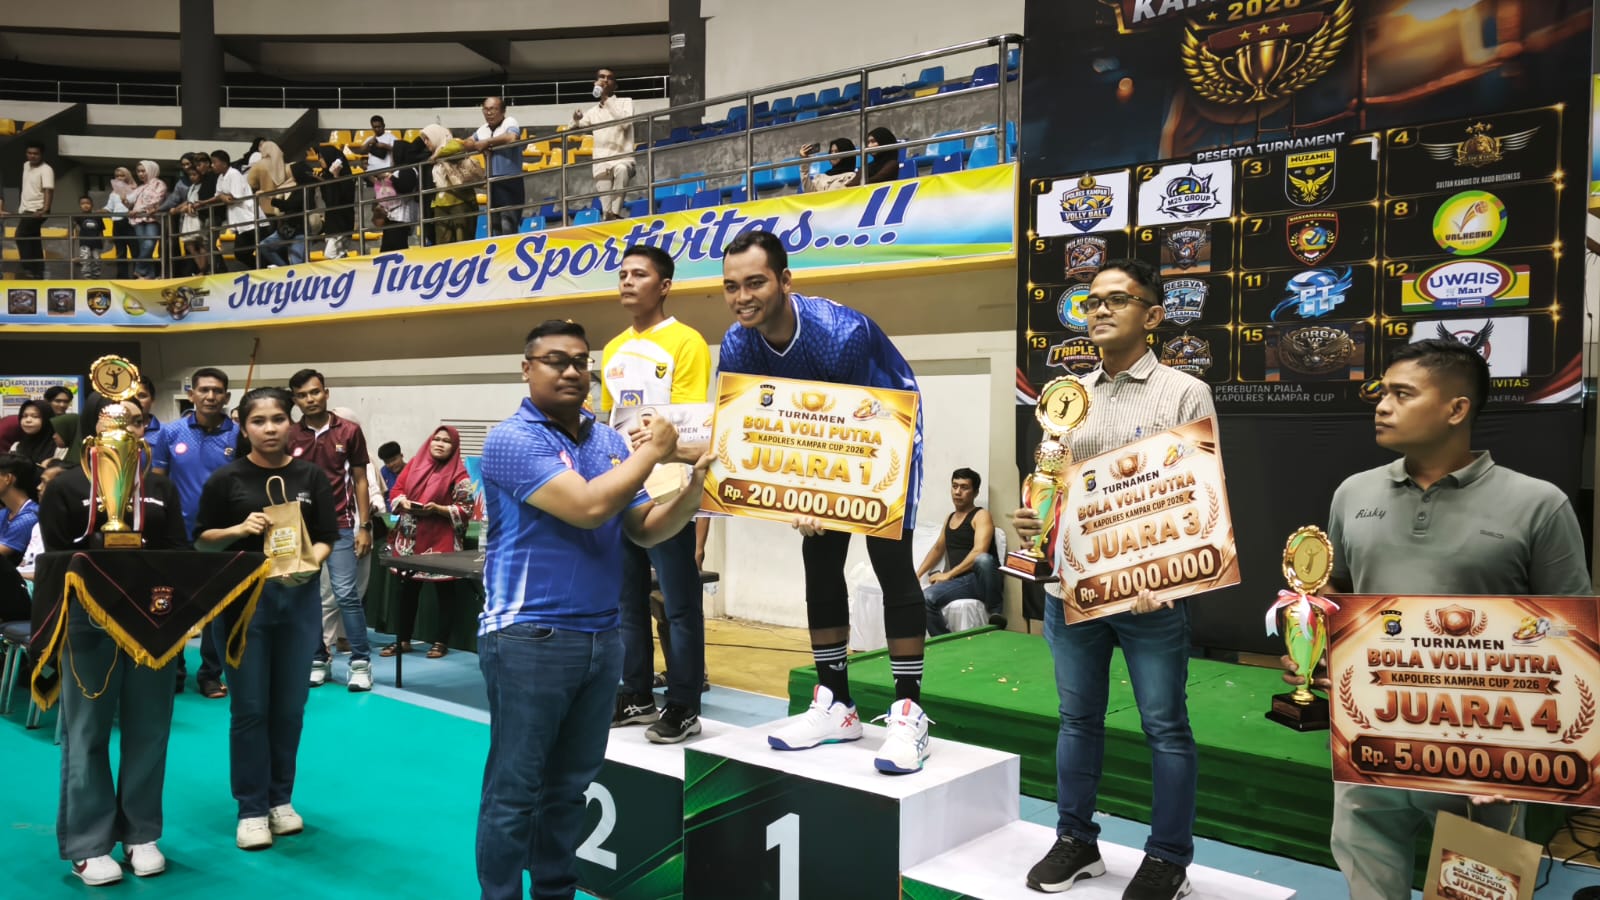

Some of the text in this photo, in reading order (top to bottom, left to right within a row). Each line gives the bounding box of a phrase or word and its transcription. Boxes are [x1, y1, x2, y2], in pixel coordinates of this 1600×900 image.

[1394, 131, 1408, 144] 4
[1196, 132, 1344, 163] PESERTA TURNAMENT
[1143, 168, 1153, 180] 2
[1250, 161, 1262, 174] 3
[1496, 172, 1521, 182] BUSINESS
[1038, 182, 1045, 192] 1
[1184, 194, 1211, 203] GROUP
[1065, 208, 1108, 221] VOLLY BALL
[1394, 202, 1408, 216] 8
[1251, 219, 1263, 232] 7
[1141, 230, 1152, 242] 6
[1035, 240, 1045, 251] 5
[1386, 263, 1408, 277] 12
[228, 269, 356, 314] Junjung
[372, 244, 497, 300] Tinggi
[1245, 274, 1262, 287] 11
[1430, 272, 1500, 288] UWAIS
[1034, 289, 1044, 300] 9
[1300, 284, 1334, 302] PT
[1458, 287, 1482, 295] Mart
[1243, 329, 1263, 342] 15
[1385, 322, 1408, 336] 16
[1031, 337, 1048, 348] 13
[1146, 334, 1154, 345] 4
[1054, 346, 1096, 361] TRIPLE
[1216, 384, 1302, 393] PEREBUTAN PIALA
[1492, 379, 1530, 388] IVITAS
[1215, 394, 1335, 402] KAPOLRES KAMPAR CUP
[778, 409, 845, 424] TURNAMEN
[743, 416, 882, 445] BOLA VOLI PUTRA
[758, 434, 864, 454] KAPOLRES KAMPAR CUP 2026
[741, 447, 872, 486] JUARA 1
[1102, 470, 1160, 495] TURNAMEN
[1077, 470, 1196, 522] BOLA VOLI PUTRA
[724, 485, 881, 522] Rp. 20.000.000
[1093, 495, 1184, 528] KAPOLRES KAMPAR CUP 2026
[1355, 508, 1386, 520] Risky
[1086, 508, 1200, 564] JUARA 3
[1080, 549, 1214, 603] Rp. 7.000.000
[1411, 637, 1505, 650] TURNAMEN
[1367, 648, 1562, 675] BOLA VOLI PUTRA
[1391, 673, 1539, 690] KAPOLRES KAMPAR CUP 2026
[1374, 689, 1562, 733] JUARA 4
[1361, 741, 1577, 786] Rp. 5.000.000
[576, 781, 618, 871] 2
[766, 812, 800, 900] 1
[1452, 878, 1494, 900] JUARA
